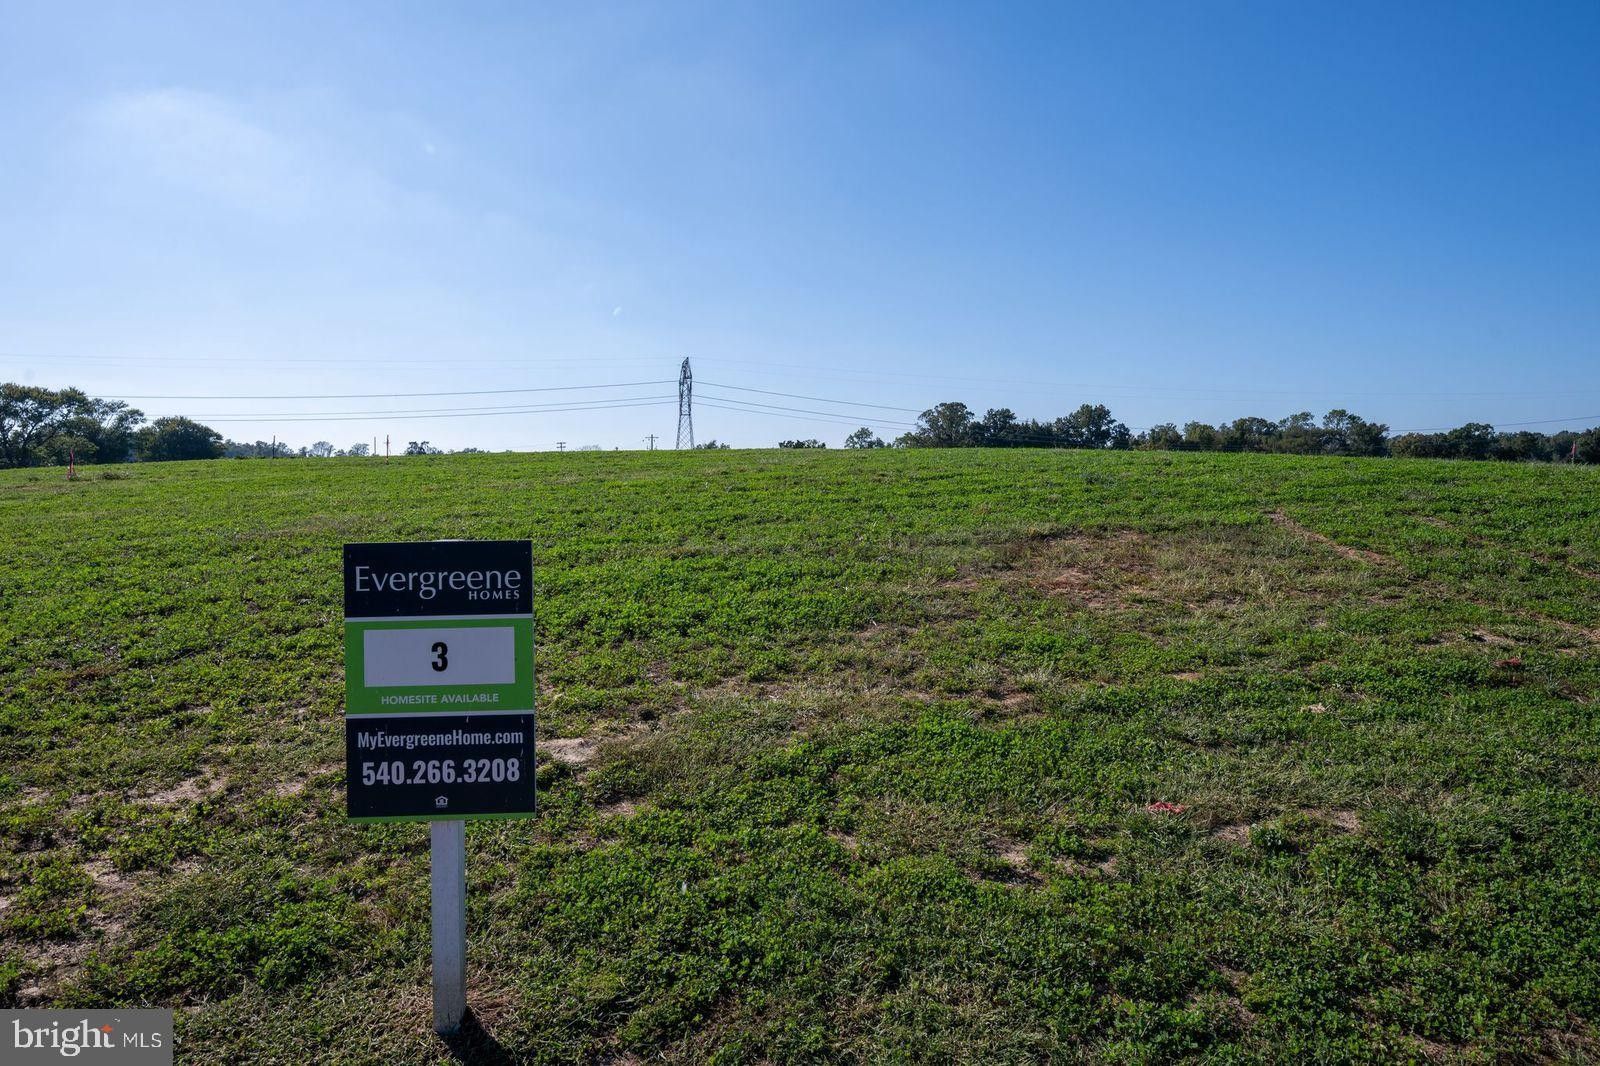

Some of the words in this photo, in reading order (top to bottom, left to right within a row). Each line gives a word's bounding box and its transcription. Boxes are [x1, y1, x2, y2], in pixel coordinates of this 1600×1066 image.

[355, 565, 521, 600] Evergreene
[468, 589, 520, 600] HOMES
[431, 641, 449, 672] 3
[381, 694, 438, 705] HOMESITE
[440, 693, 499, 704] AVAILABLE
[357, 729, 523, 750] MyEvergreeneHome.com
[362, 758, 520, 786] 540.266.3208
